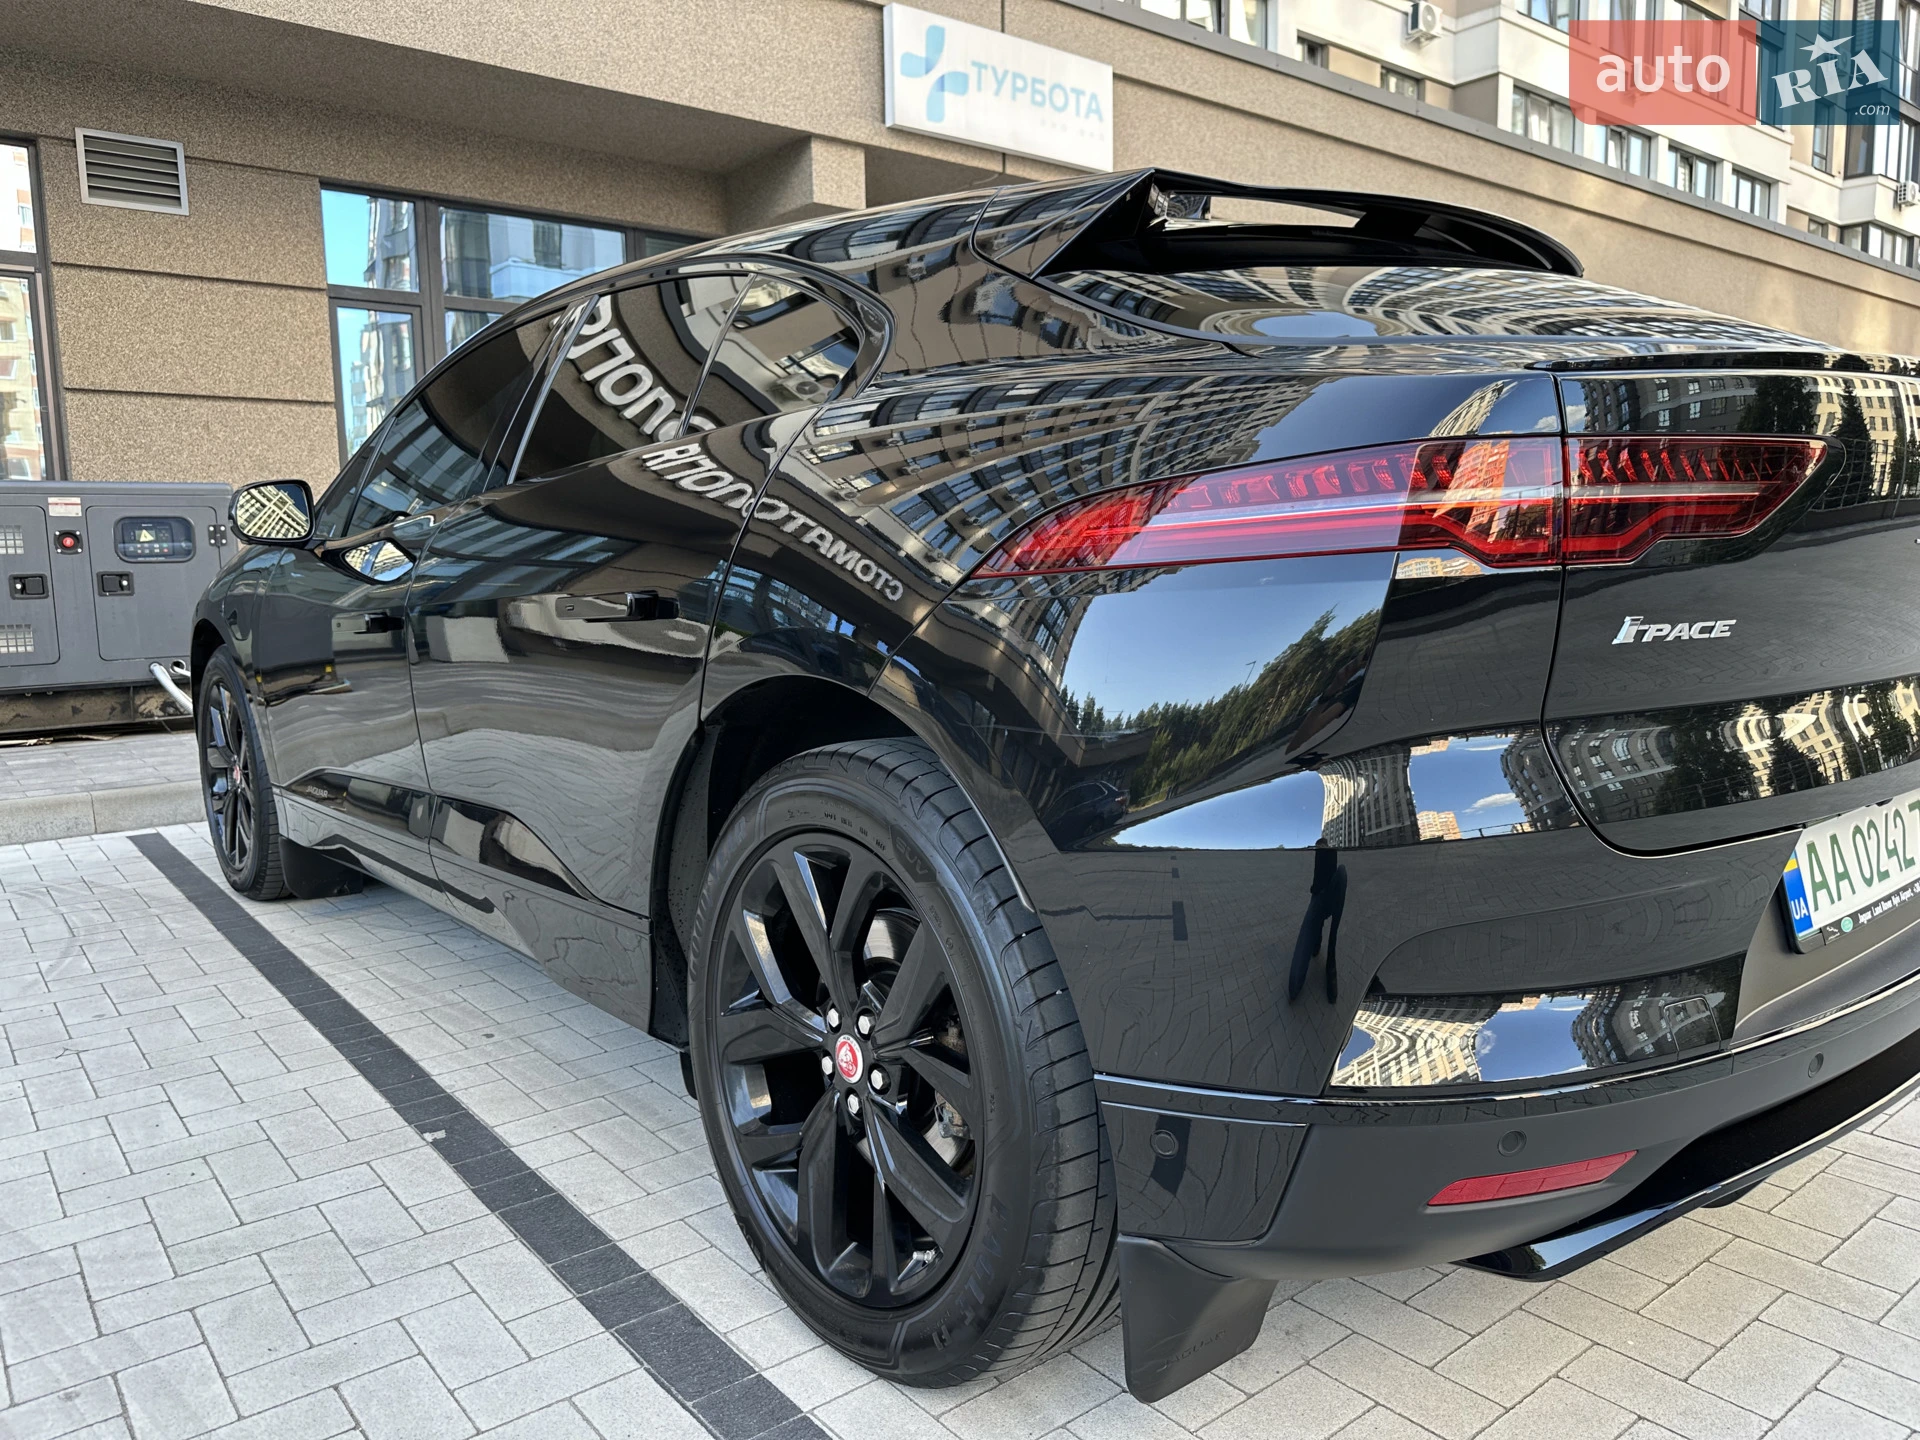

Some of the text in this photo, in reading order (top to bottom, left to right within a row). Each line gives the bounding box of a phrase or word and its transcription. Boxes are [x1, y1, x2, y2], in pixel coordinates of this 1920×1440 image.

[970, 60, 1104, 123] ТУРБОТА
[896, 837, 929, 875] SUV
[1807, 834, 1856, 912] AA
[1852, 808, 1916, 887] 0242
[1791, 897, 1809, 920] UA
